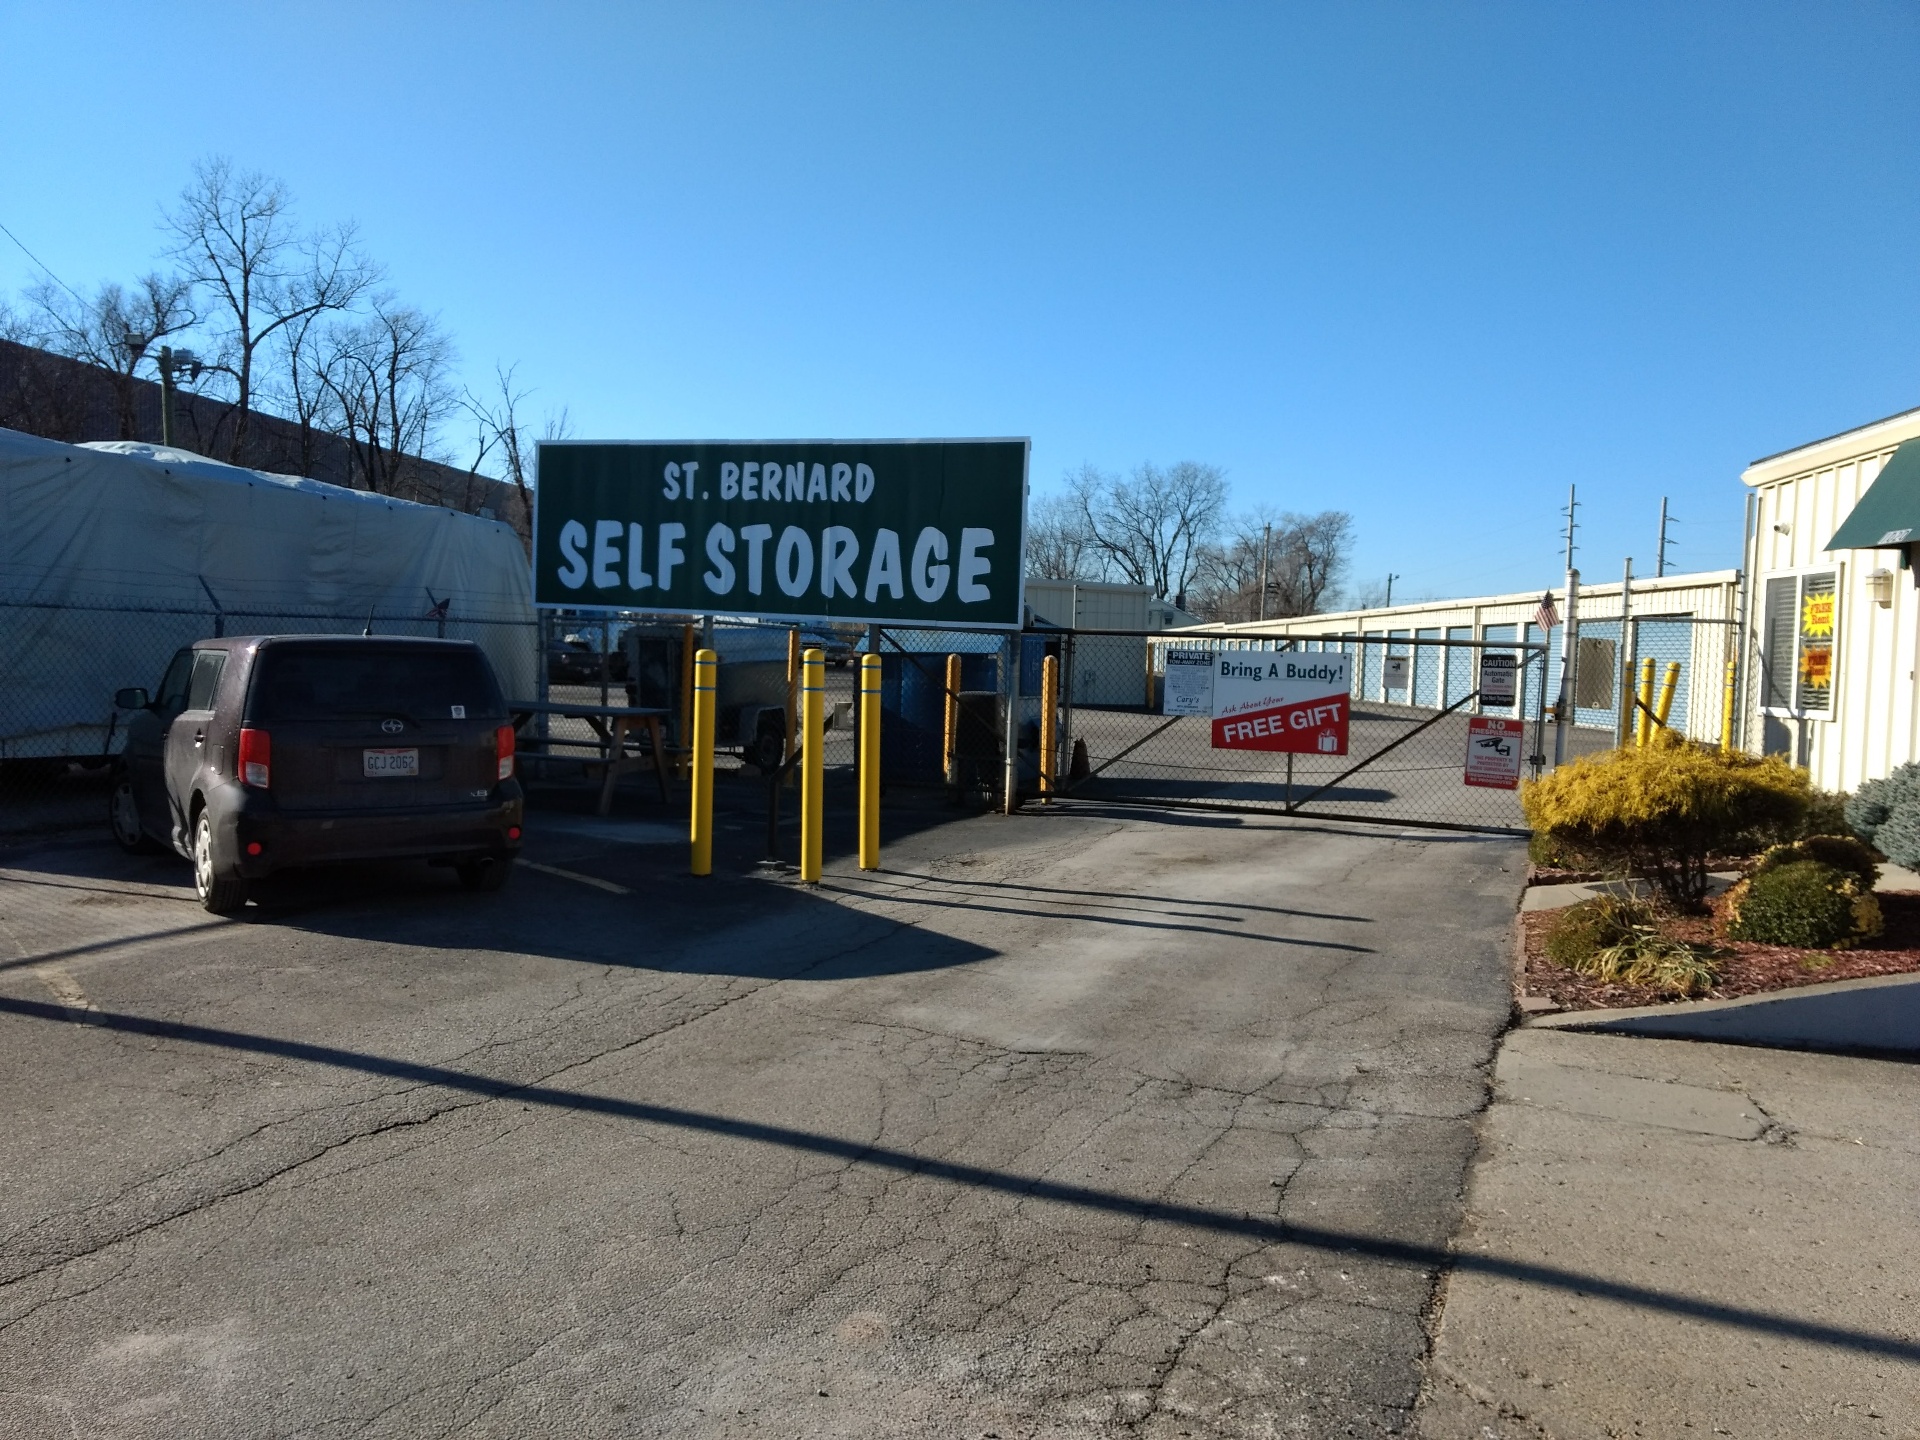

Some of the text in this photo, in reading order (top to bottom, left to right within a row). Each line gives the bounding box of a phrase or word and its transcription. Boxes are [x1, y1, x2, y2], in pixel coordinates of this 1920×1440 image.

[662, 461, 876, 503] ST. BERNARD
[557, 518, 996, 604] SELF STORAGE
[1172, 651, 1211, 661] PRIVATE
[1482, 659, 1516, 668] CAUTION
[1221, 661, 1262, 682] Bring
[1268, 663, 1279, 678] A
[1286, 663, 1343, 684] Buddy!
[1484, 670, 1514, 678] Automatic
[1222, 705, 1237, 716] Ask
[1240, 701, 1261, 711] About
[1262, 696, 1284, 707] Your
[1223, 703, 1342, 743] FREE GIFT
[1487, 720, 1506, 730] NO
[1471, 728, 1522, 738] TRESPASSING
[367, 755, 415, 770] GCJ 2062
